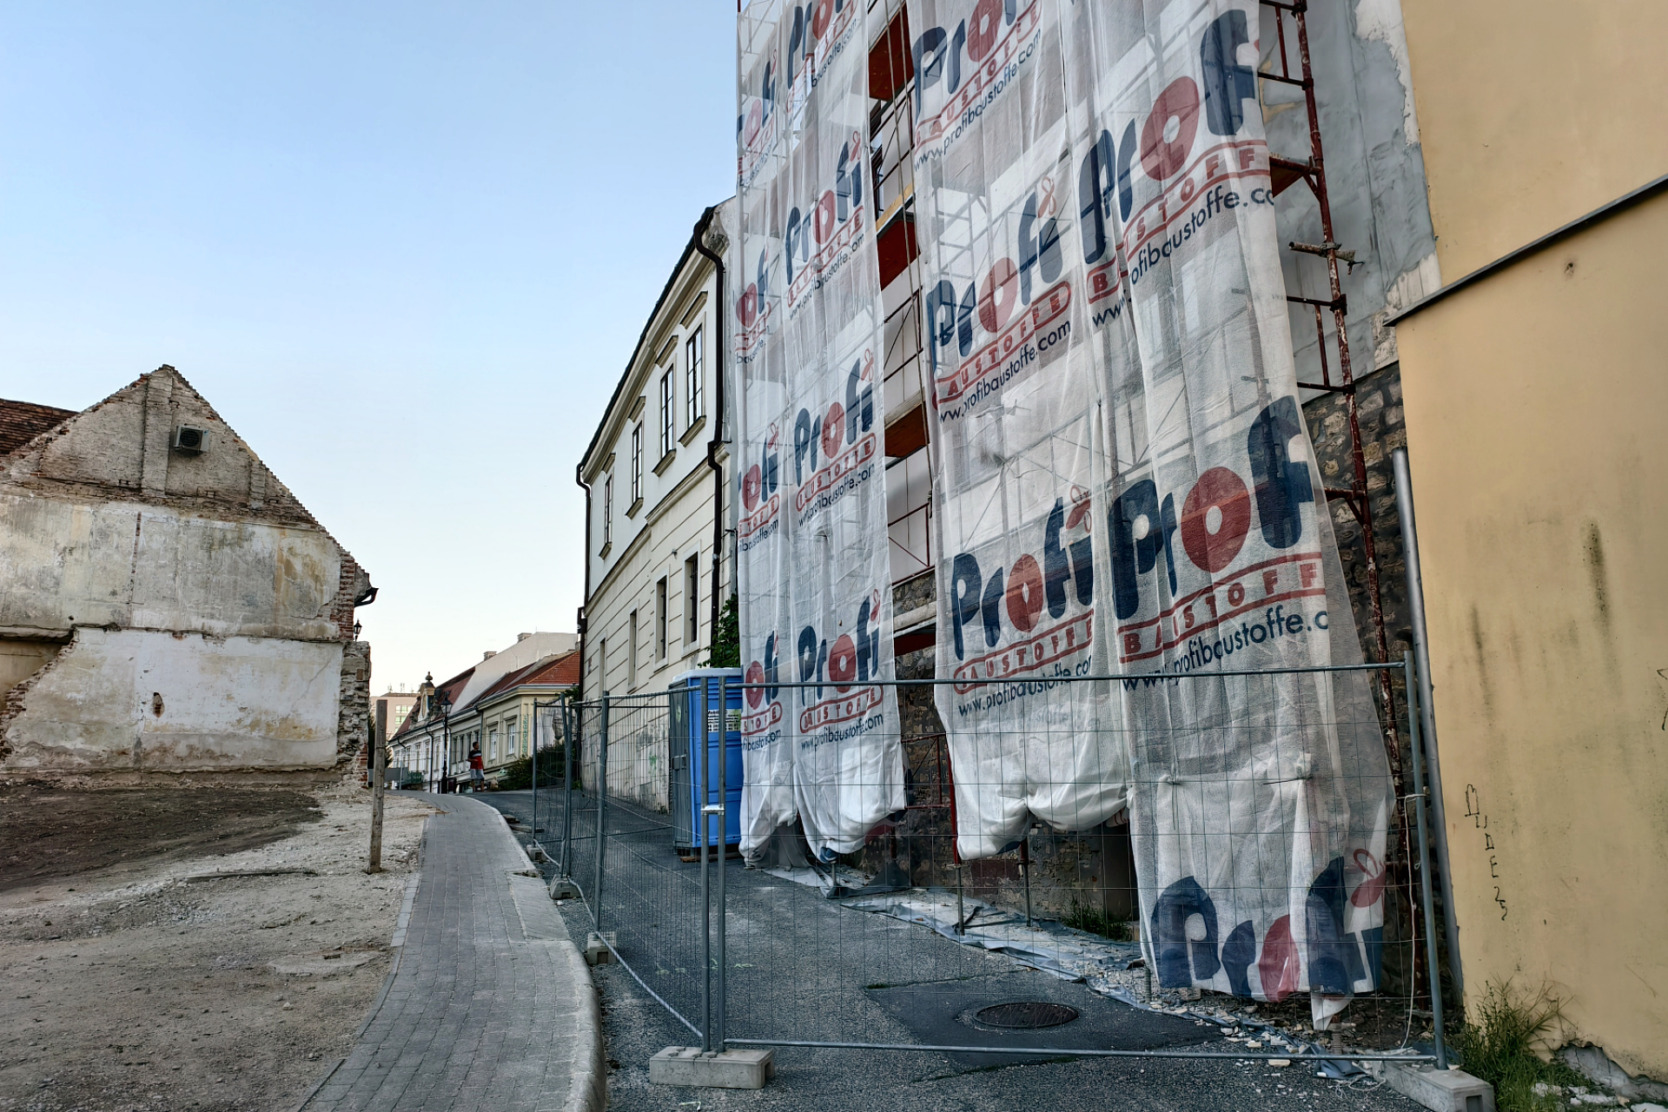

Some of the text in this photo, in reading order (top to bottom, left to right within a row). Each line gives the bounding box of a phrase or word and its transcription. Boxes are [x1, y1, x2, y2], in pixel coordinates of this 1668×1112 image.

[786, 130, 864, 286] Profi
[1079, 9, 1257, 265] Prof
[926, 177, 1064, 375] Profi
[945, 292, 1062, 397] AUSTOFFE
[794, 348, 875, 488] Profi
[797, 588, 881, 707] Profi
[950, 485, 1093, 661] Profi
